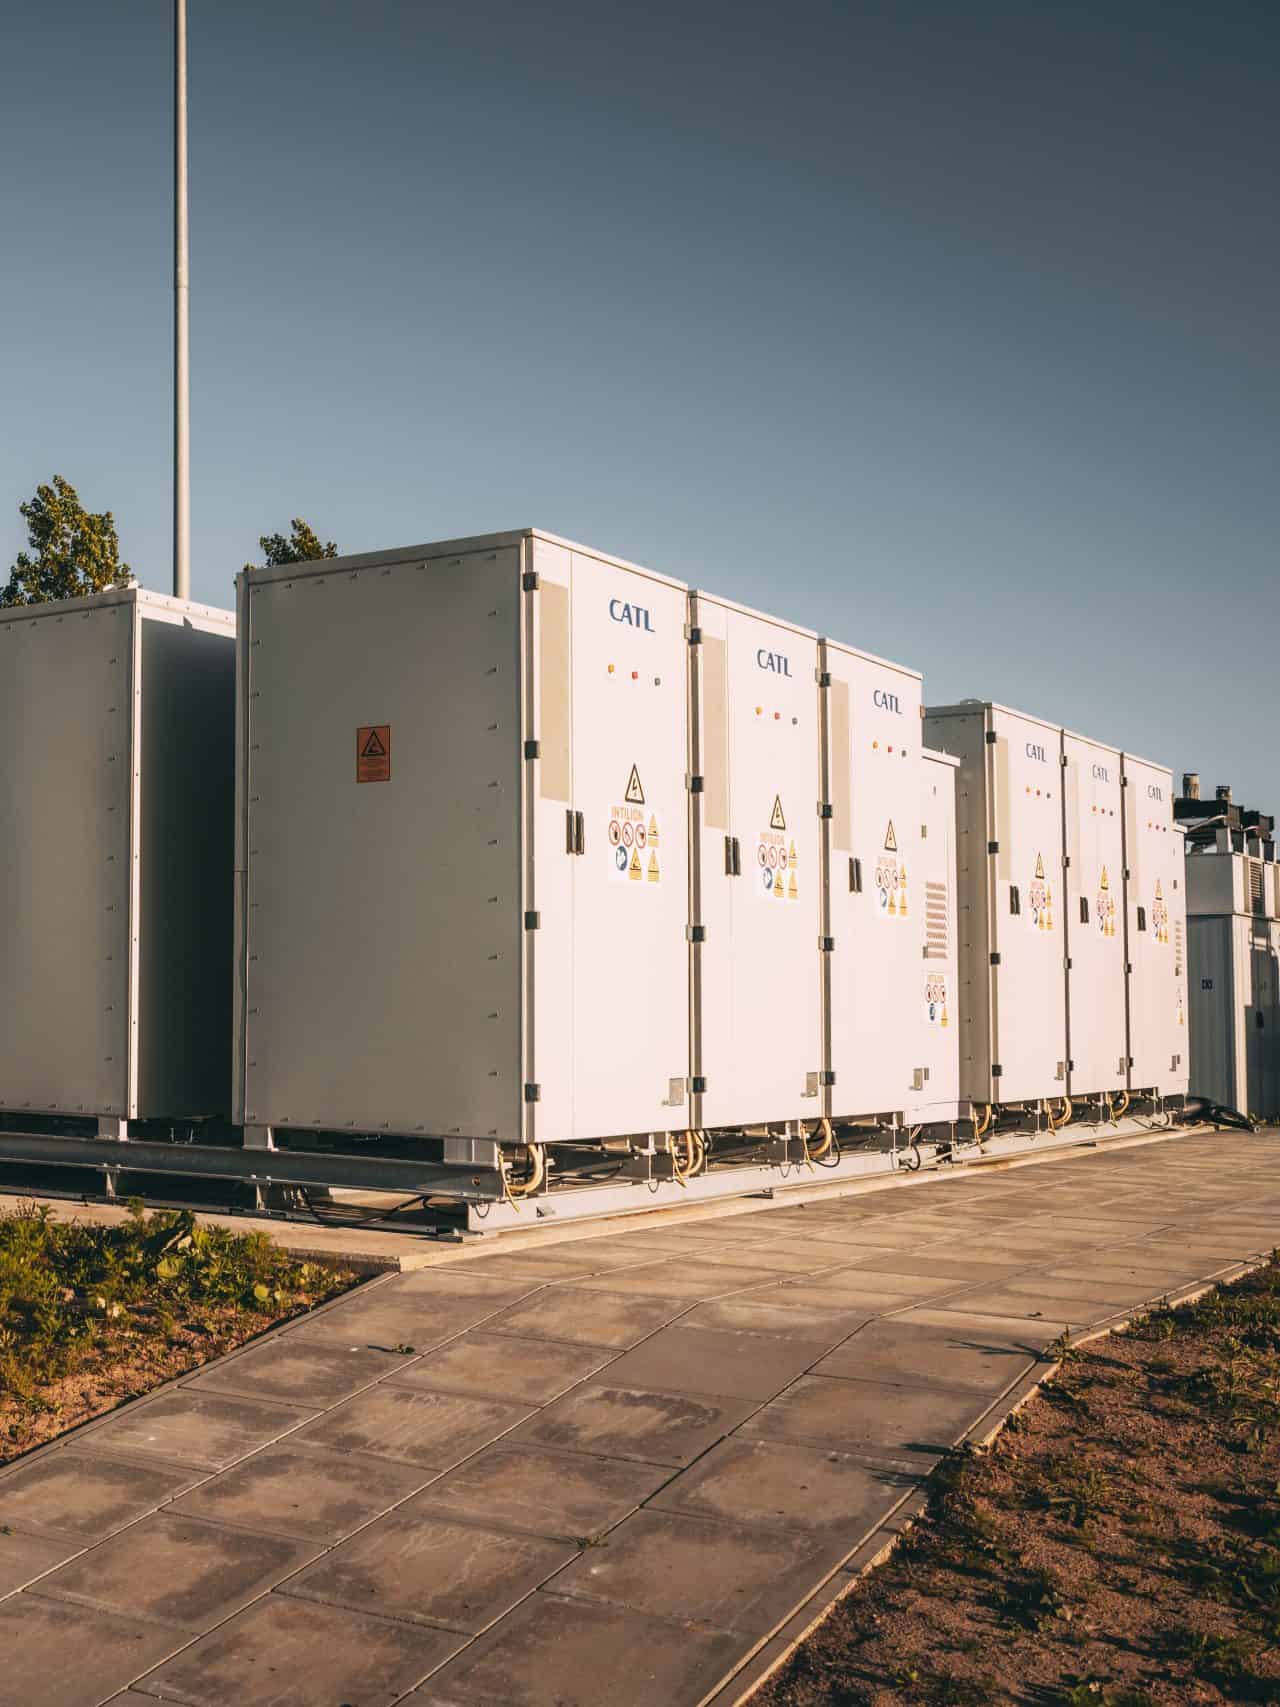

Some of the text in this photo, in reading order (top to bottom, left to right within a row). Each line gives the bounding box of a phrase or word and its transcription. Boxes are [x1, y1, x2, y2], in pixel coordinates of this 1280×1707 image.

[609, 598, 655, 632] CATL
[757, 649, 792, 678] CATL
[874, 690, 902, 714] CATL
[1026, 743, 1047, 762] CATL
[1092, 764, 1109, 783] CATL
[1147, 785, 1164, 801] CATL
